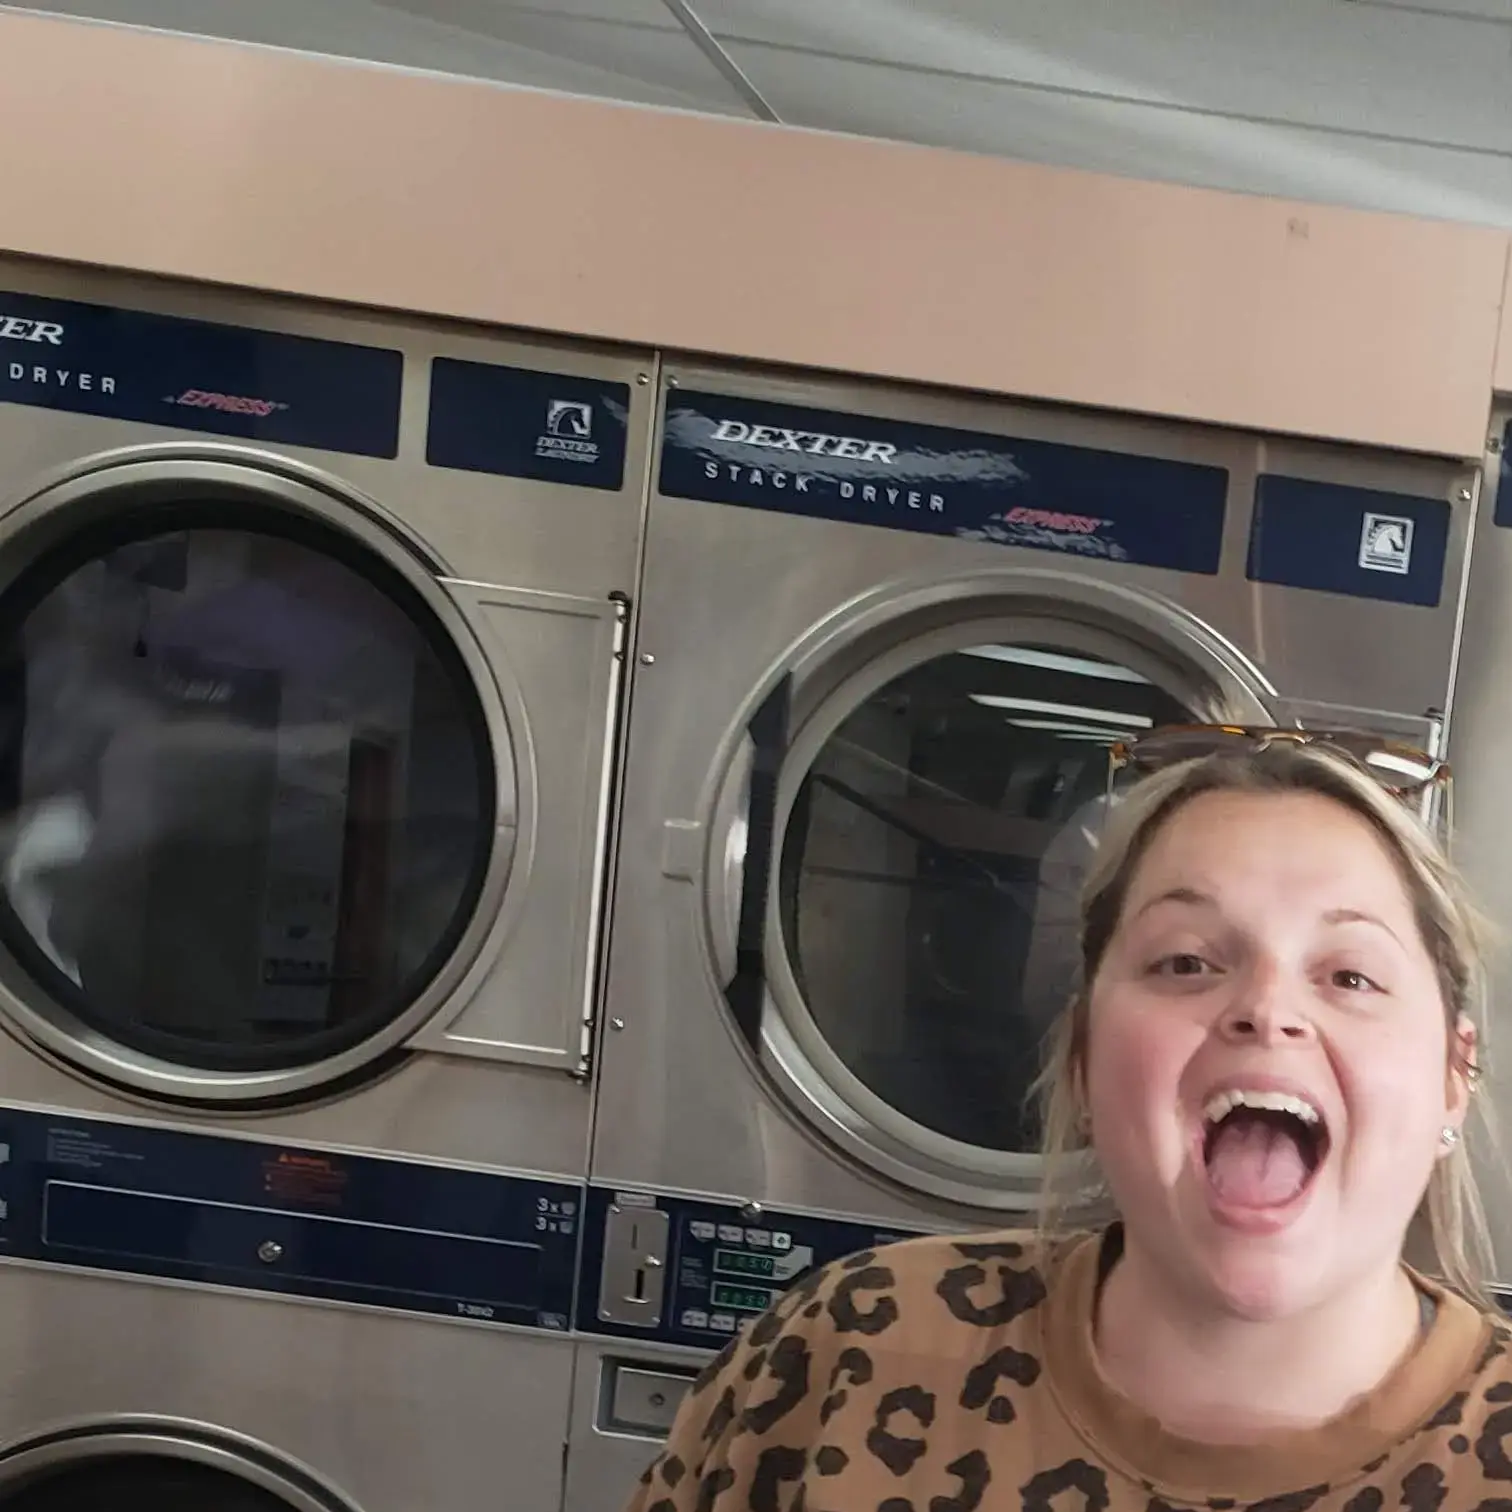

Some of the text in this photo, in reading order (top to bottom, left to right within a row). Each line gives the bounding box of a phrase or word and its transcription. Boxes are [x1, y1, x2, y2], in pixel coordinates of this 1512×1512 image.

[9, 362, 116, 395] DRYER
[710, 419, 898, 465] DEXTER
[704, 461, 944, 513] STACK DRYER
